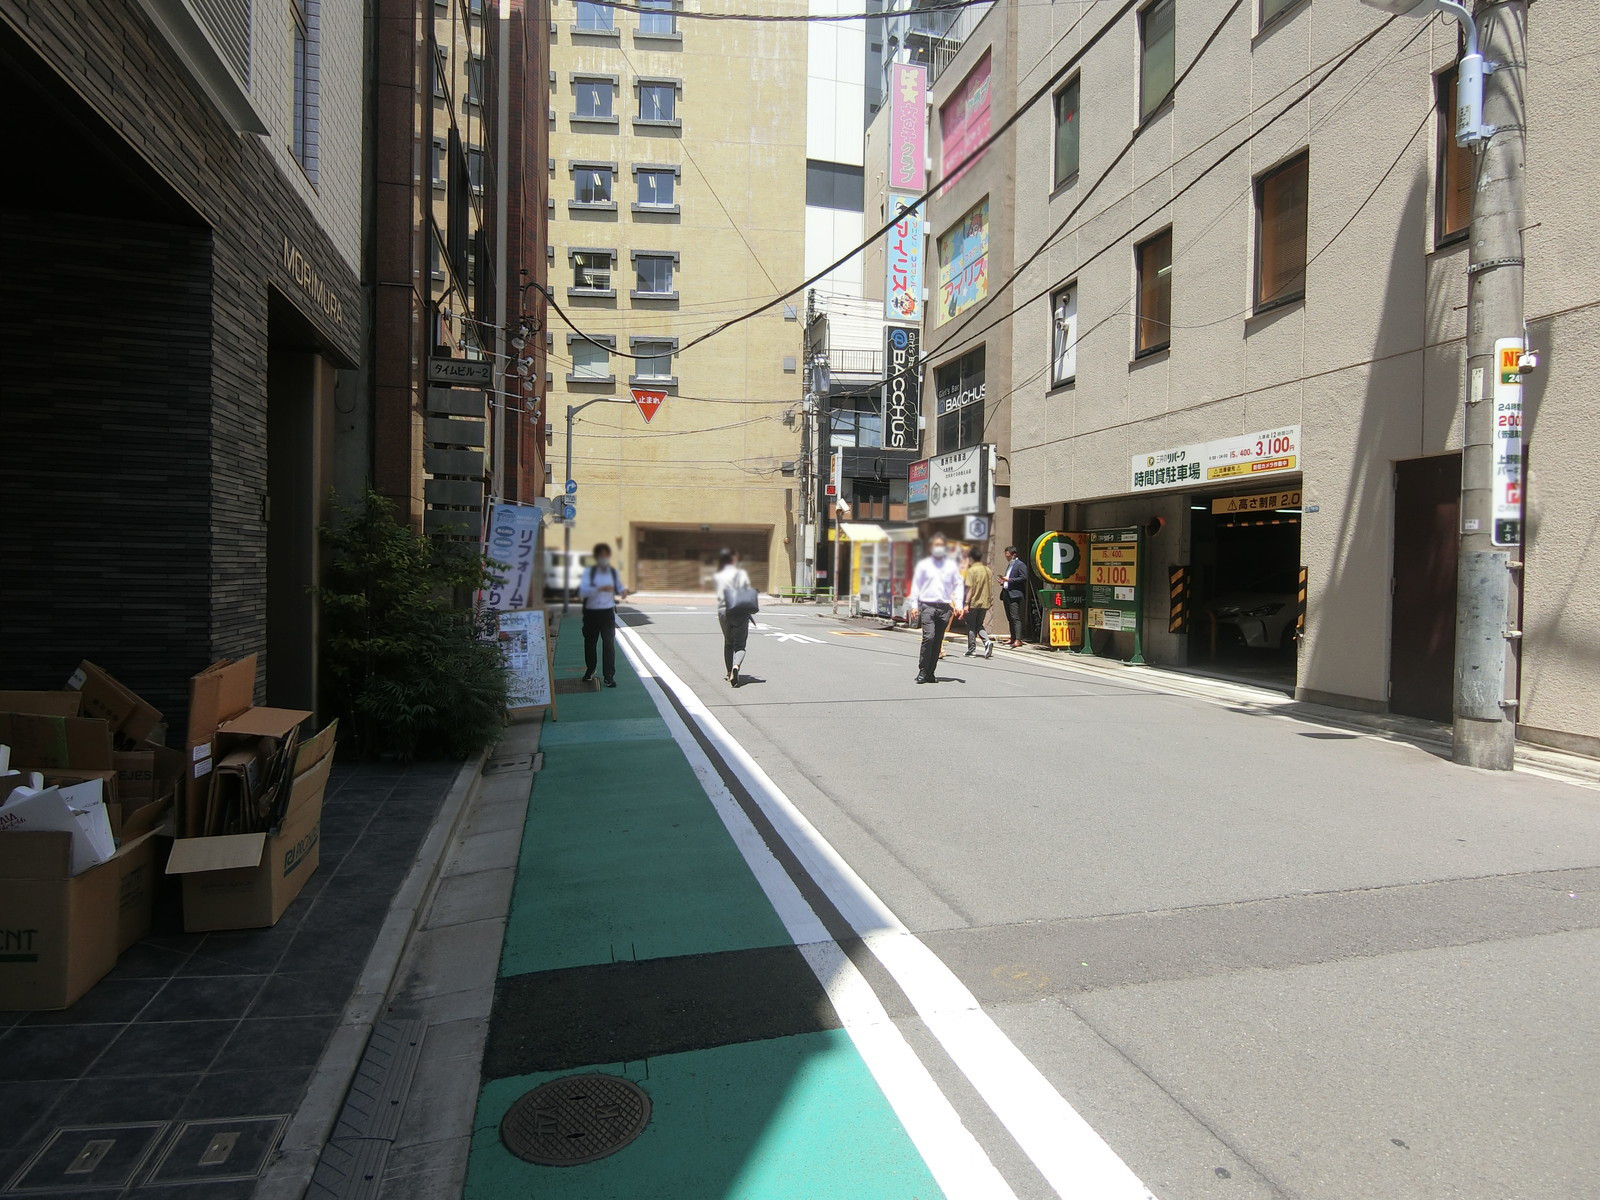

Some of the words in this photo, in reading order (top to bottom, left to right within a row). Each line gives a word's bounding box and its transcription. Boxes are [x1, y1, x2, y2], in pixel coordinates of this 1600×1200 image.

[284, 236, 344, 328] MORIMURA
[944, 257, 985, 305] アイリス
[638, 395, 661, 405] 止まれ
[891, 350, 907, 448] BACCHUS
[945, 383, 987, 412] BACCHUS
[1134, 462, 1201, 487] 時間貸駐車場
[942, 481, 977, 498] よしみ食堂
[1238, 495, 1277, 511] 高さ制限
[1052, 542, 1075, 574] P
